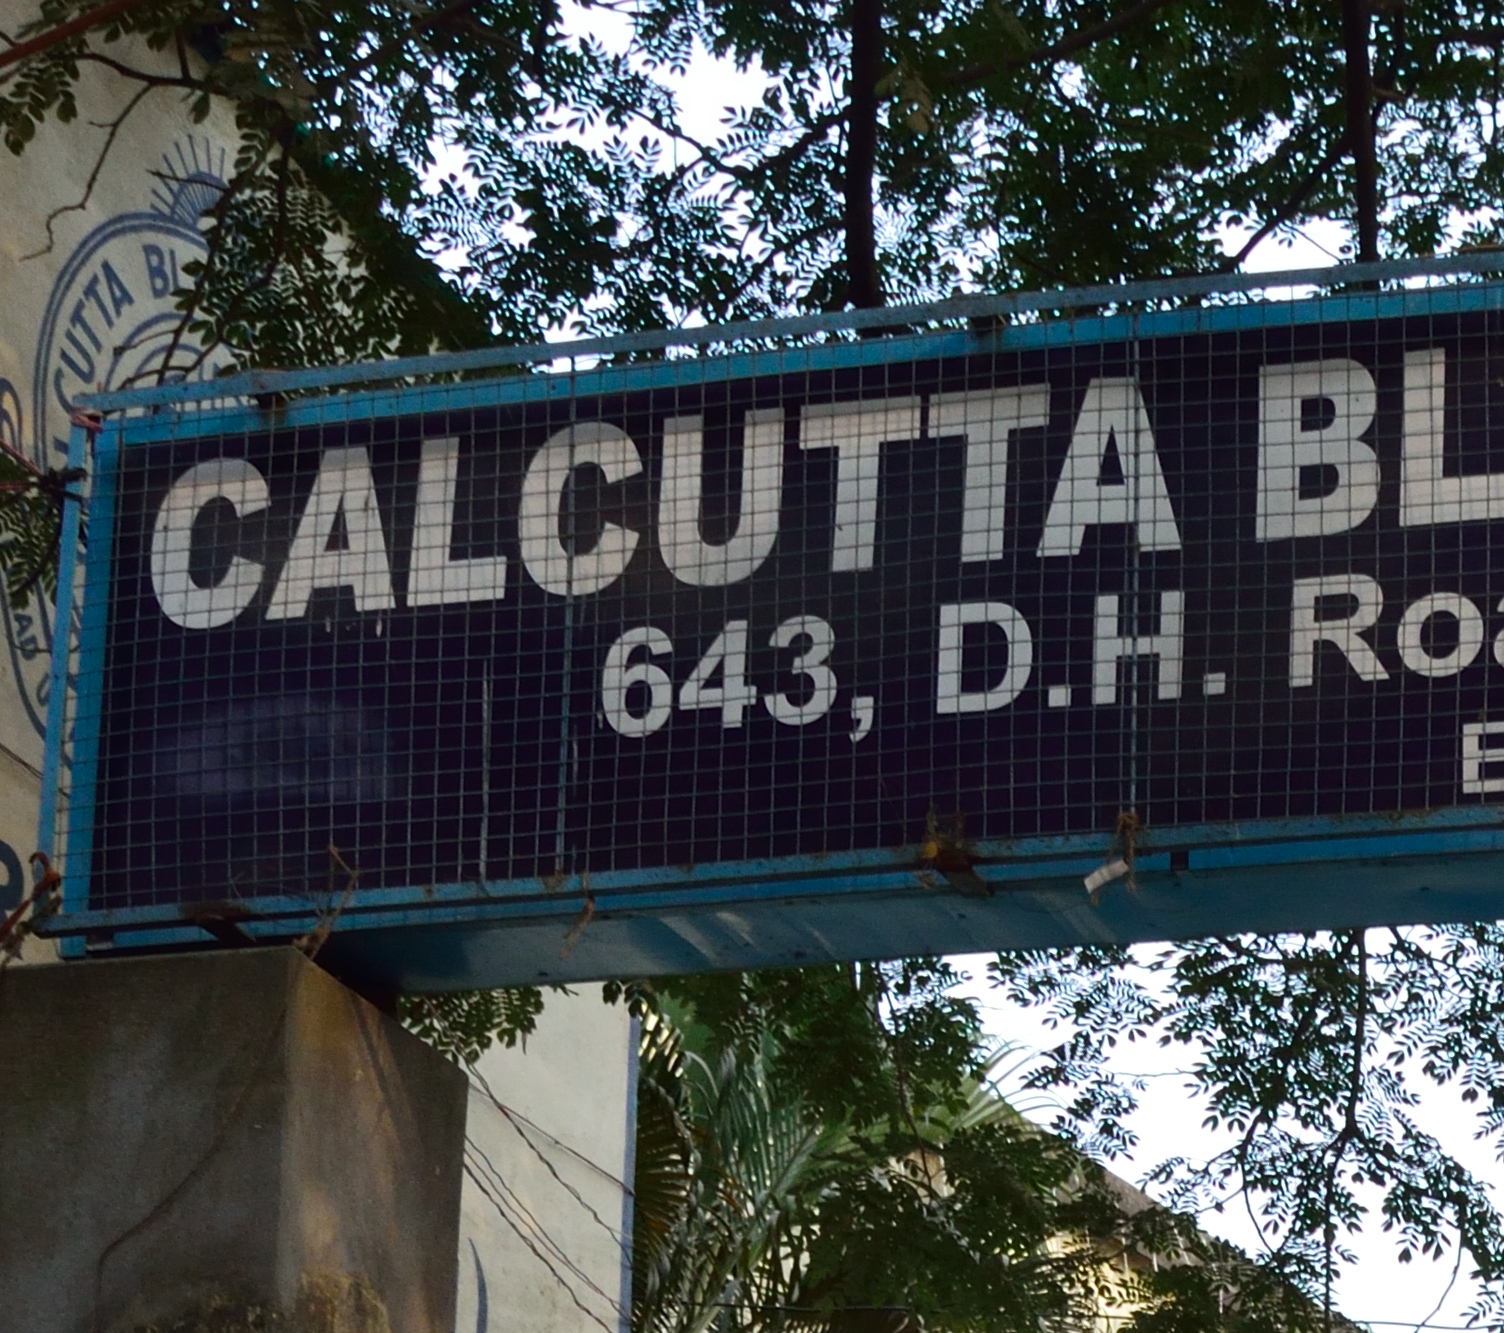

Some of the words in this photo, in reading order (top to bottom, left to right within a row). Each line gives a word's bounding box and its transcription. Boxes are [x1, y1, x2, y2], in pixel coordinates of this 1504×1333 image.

[150, 366, 1182, 630] CALCUTTA
[600, 615, 875, 742] 643,
[934, 590, 1229, 714] D.H.
